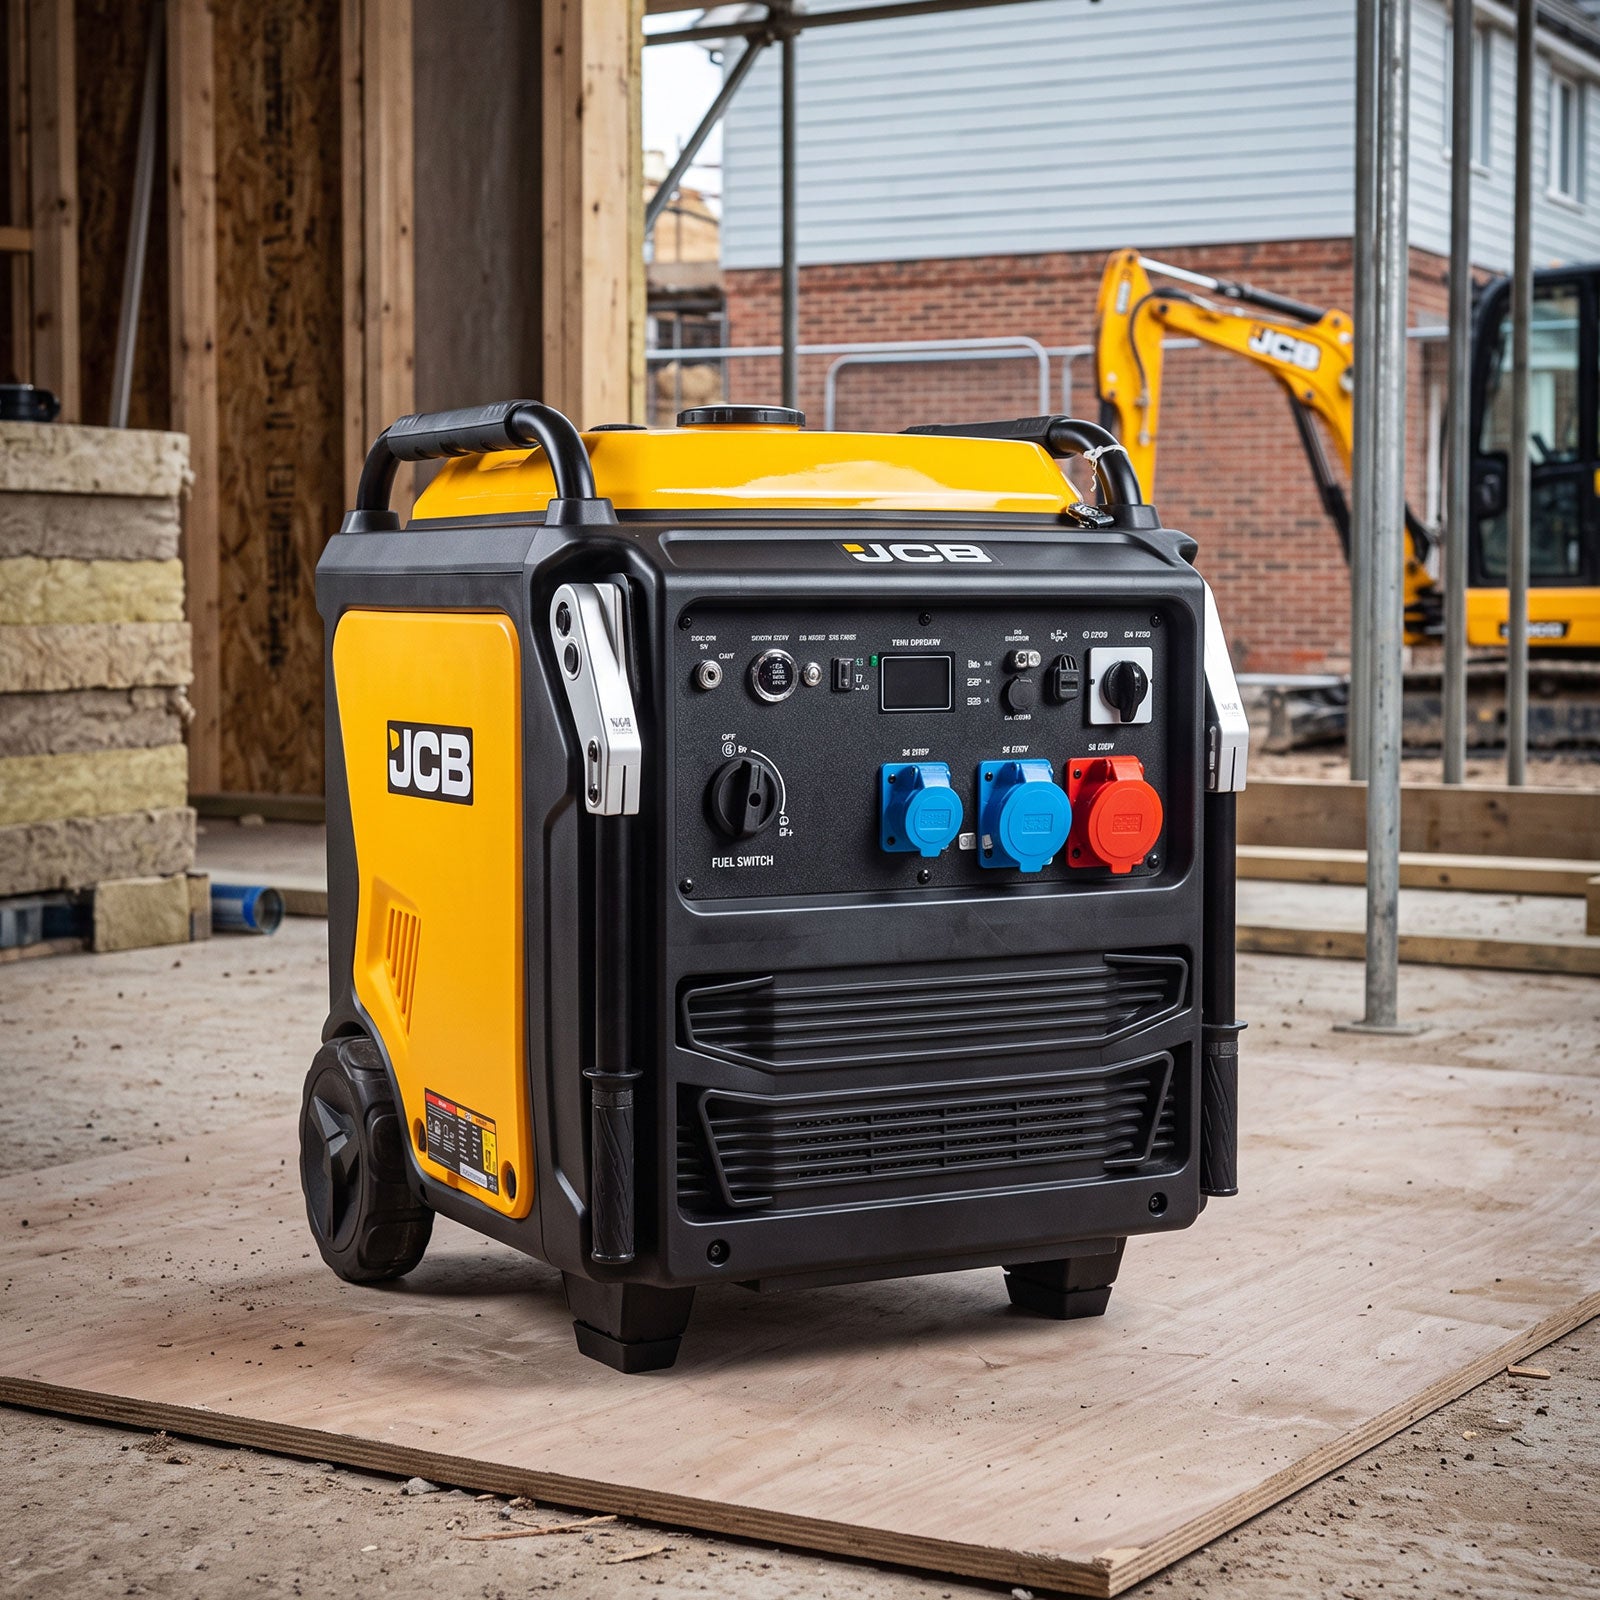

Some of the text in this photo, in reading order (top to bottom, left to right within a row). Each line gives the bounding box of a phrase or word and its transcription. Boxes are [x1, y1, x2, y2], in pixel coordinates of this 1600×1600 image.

[848, 543, 993, 563] JCB
[721, 733, 737, 741] OFF
[388, 728, 472, 798] JCB
[711, 855, 774, 869] FUEL SWITCH
